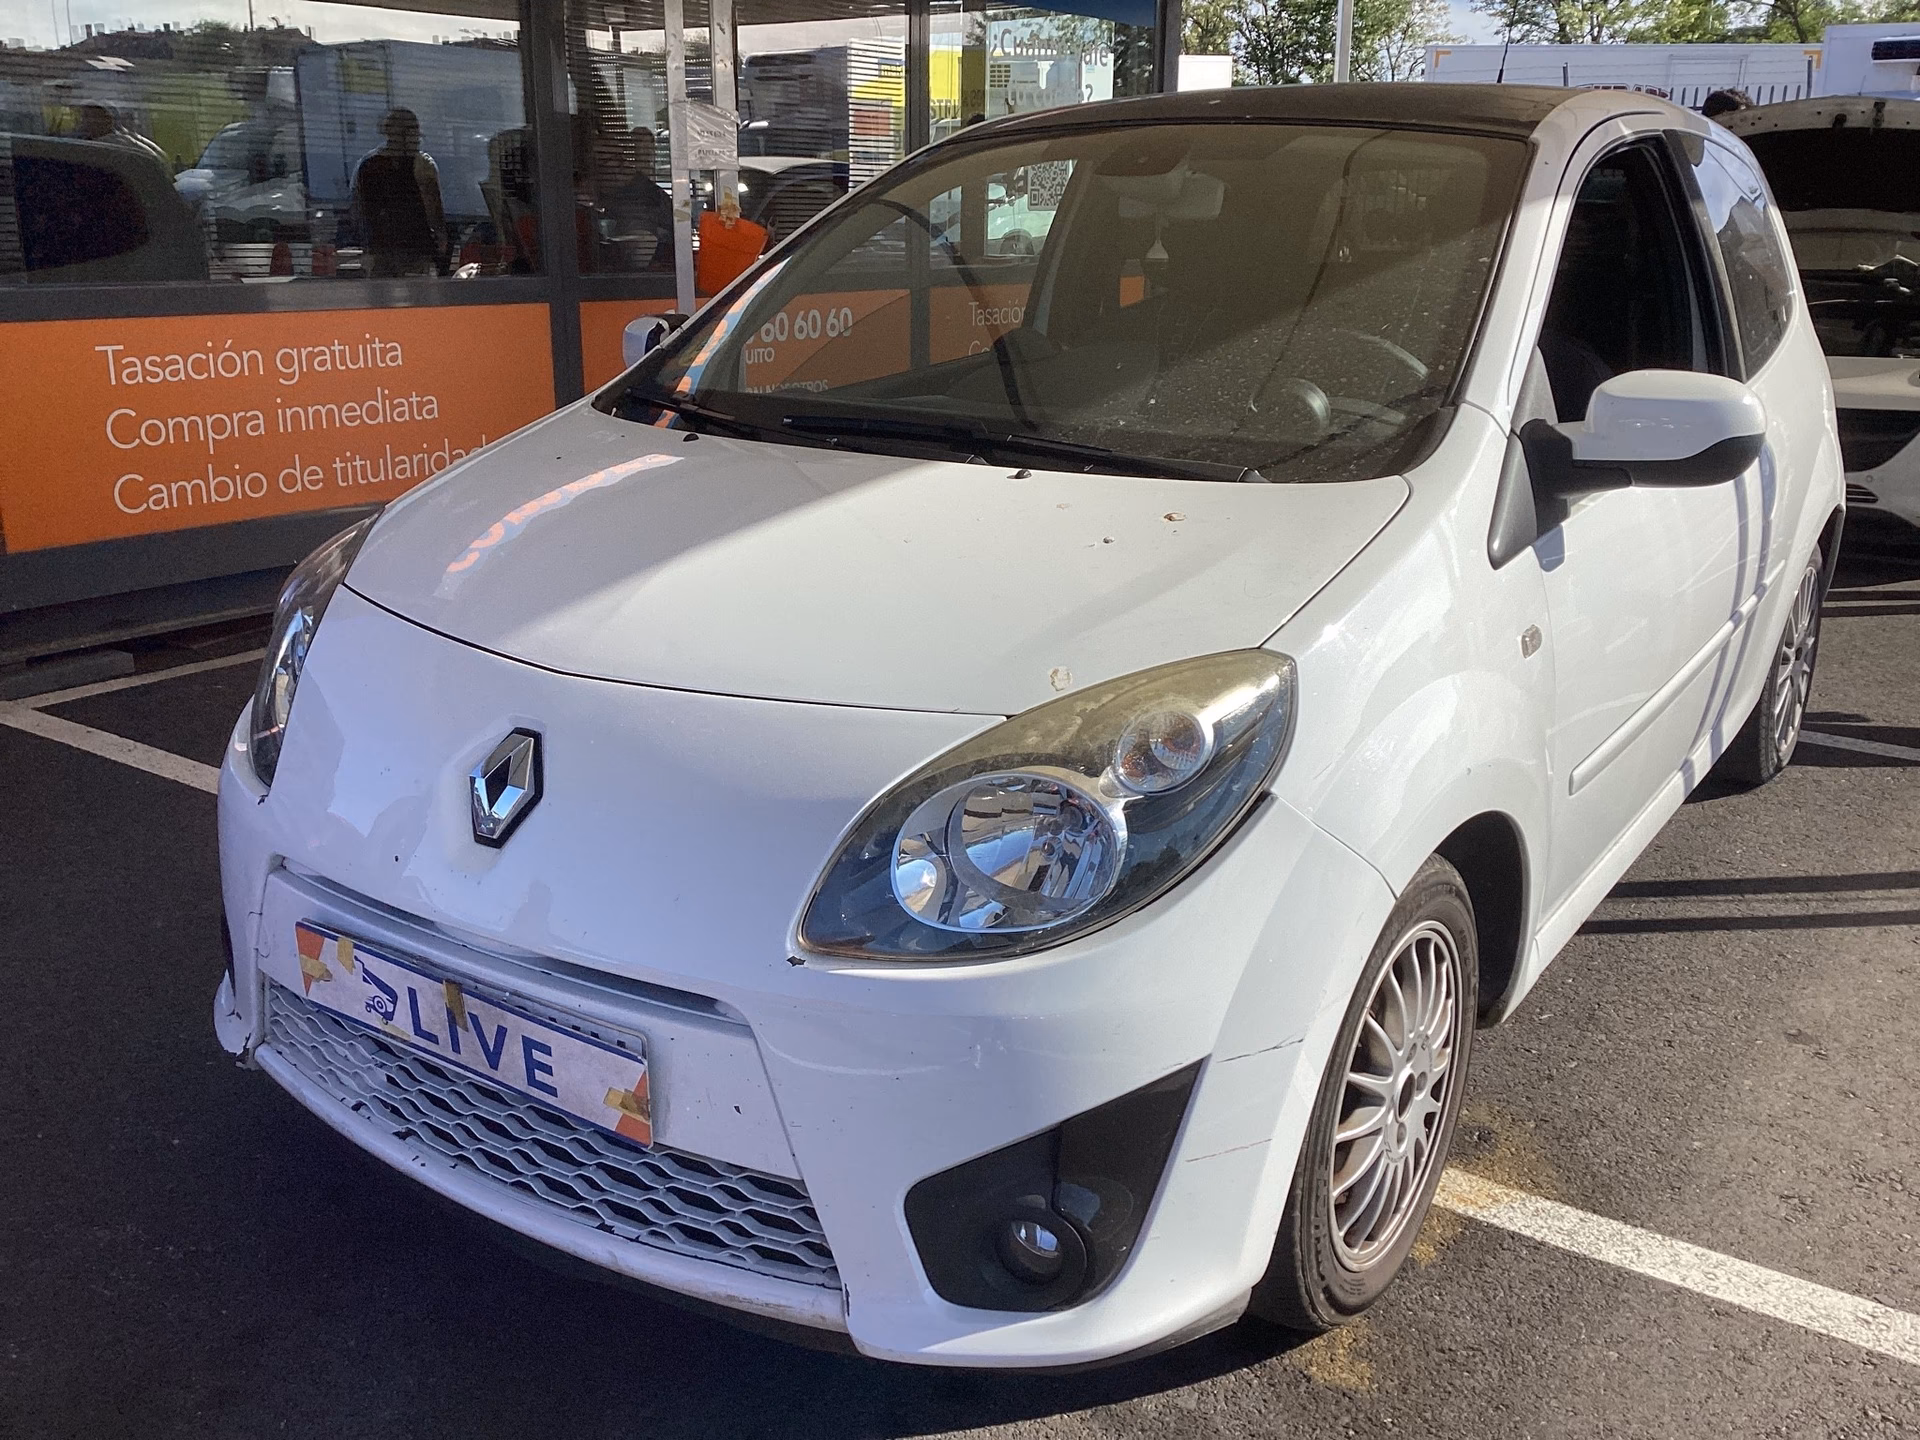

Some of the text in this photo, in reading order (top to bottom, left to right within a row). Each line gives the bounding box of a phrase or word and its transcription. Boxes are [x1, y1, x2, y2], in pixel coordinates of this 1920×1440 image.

[793, 309, 822, 340] 60
[826, 306, 853, 337] 60
[94, 333, 403, 385] Tasación gratuita
[105, 387, 439, 454] Compra inmediata
[113, 463, 268, 514] Cambio
[278, 454, 324, 493] de
[407, 986, 559, 1099] LIVE
